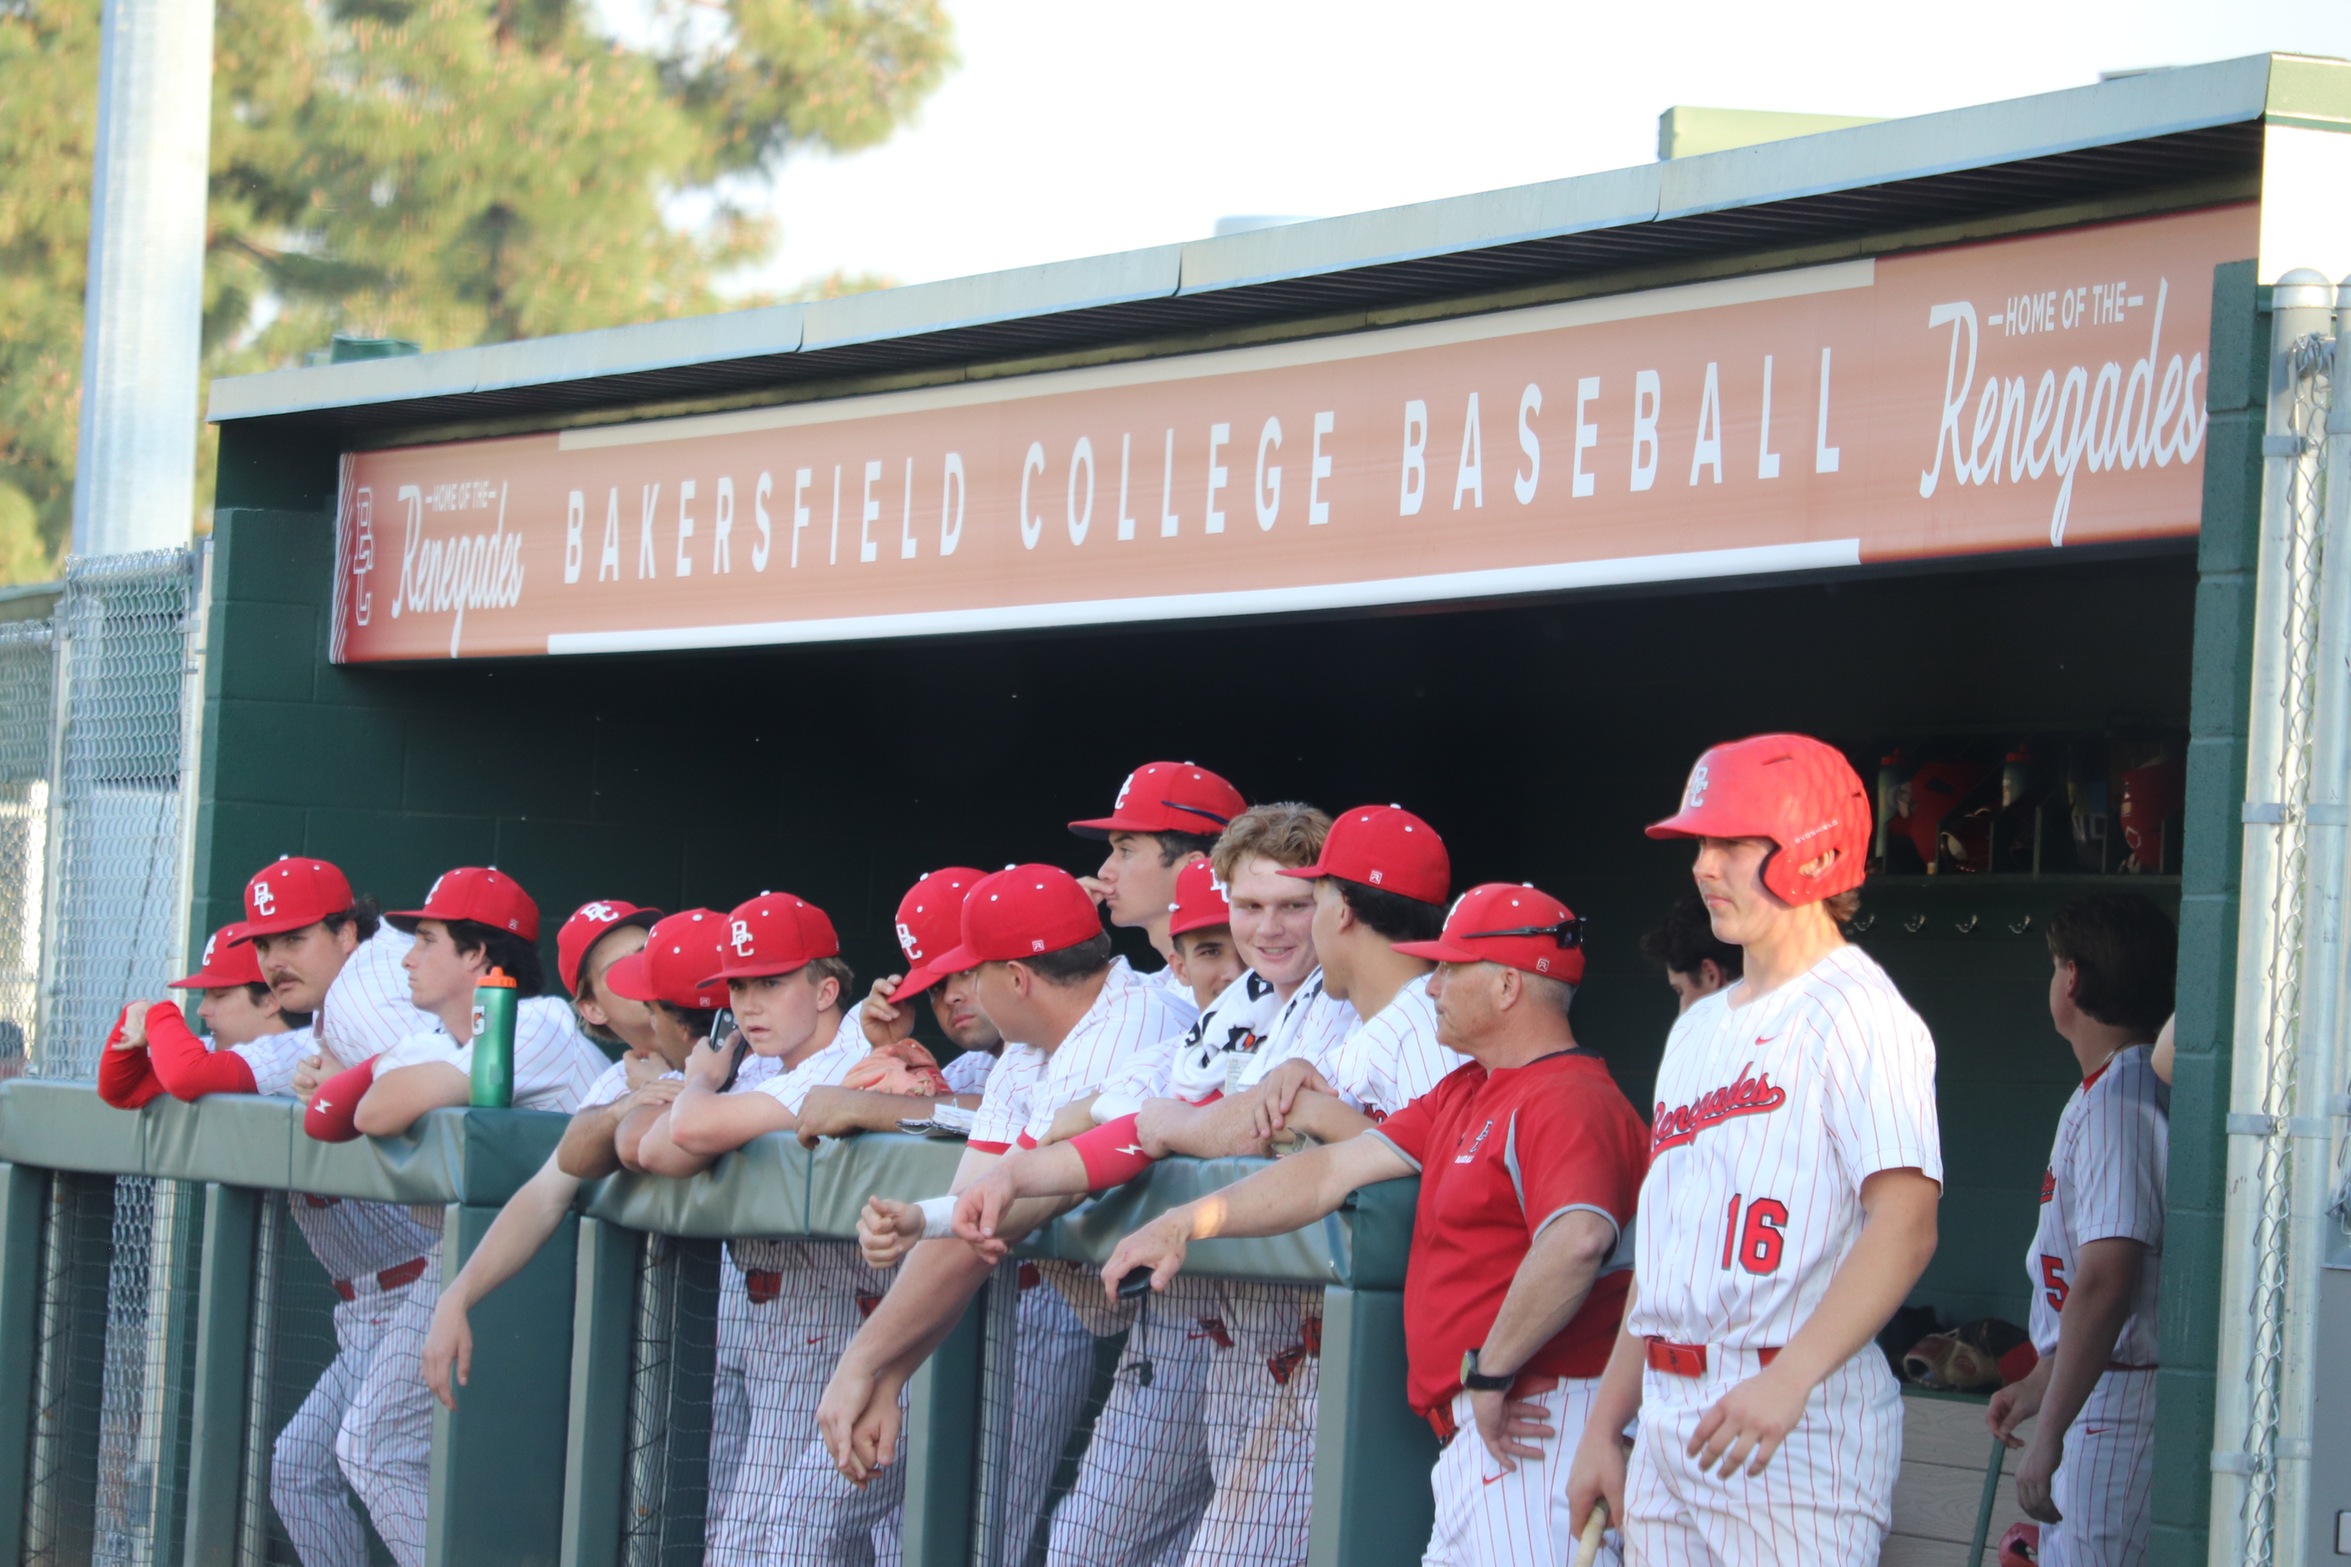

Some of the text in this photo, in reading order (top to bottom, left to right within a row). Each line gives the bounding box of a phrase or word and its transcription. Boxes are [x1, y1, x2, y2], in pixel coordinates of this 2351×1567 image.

[2061, 287, 2087, 330] OF
[1919, 276, 2206, 548] Renegades
[564, 347, 1840, 584] BAKERSFIELD COLLEGE BASEBALL
[458, 482, 471, 510] OF
[391, 479, 525, 659] Renegades
[254, 882, 276, 916] BC
[581, 902, 619, 922] BC
[730, 919, 755, 958] BC
[896, 923, 923, 960] BC
[1651, 1061, 1783, 1155] Renegades
[1722, 1193, 1788, 1276] 16
[2040, 1253, 2069, 1312] 5
